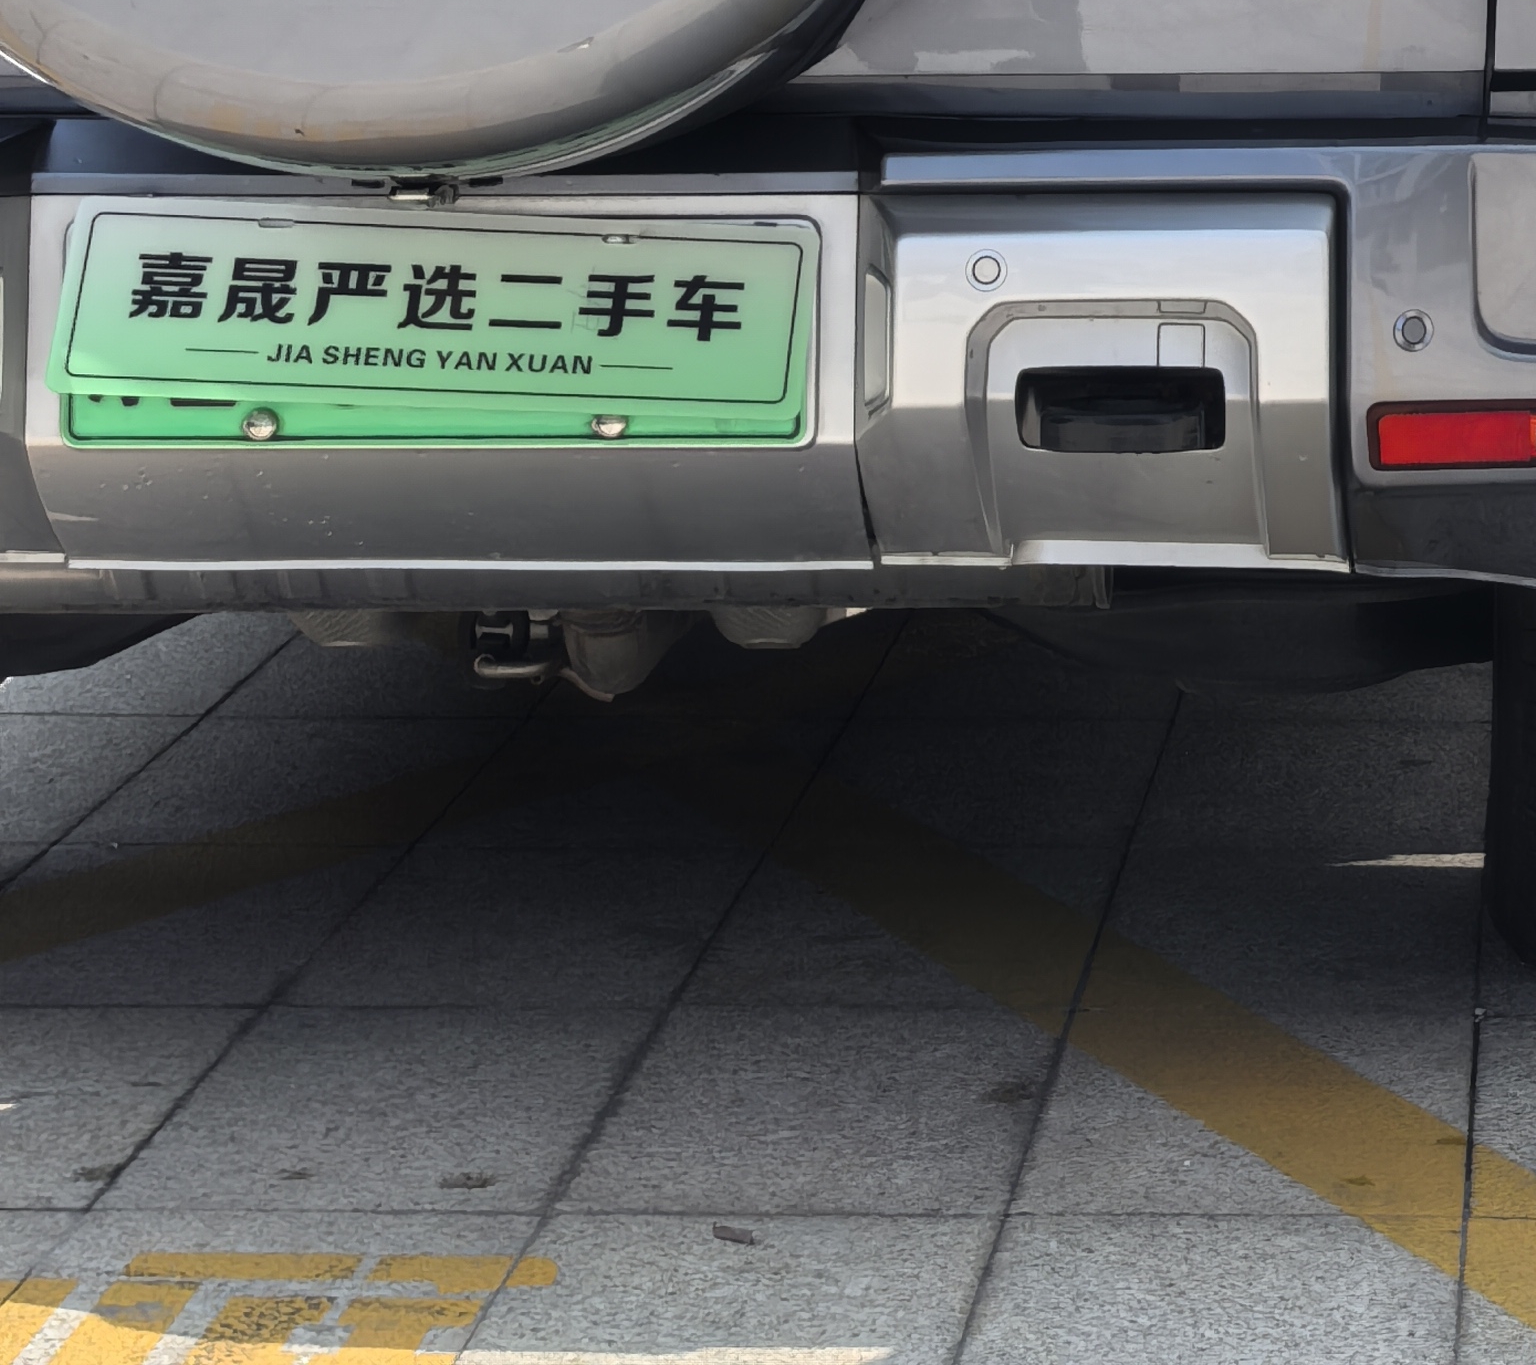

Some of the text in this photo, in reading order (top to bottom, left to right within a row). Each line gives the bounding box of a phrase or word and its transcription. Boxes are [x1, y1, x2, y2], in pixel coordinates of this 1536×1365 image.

[128, 252, 745, 342] 嘉晟严选二手车
[266, 343, 593, 375] JIA SHENG YAN XUAN
